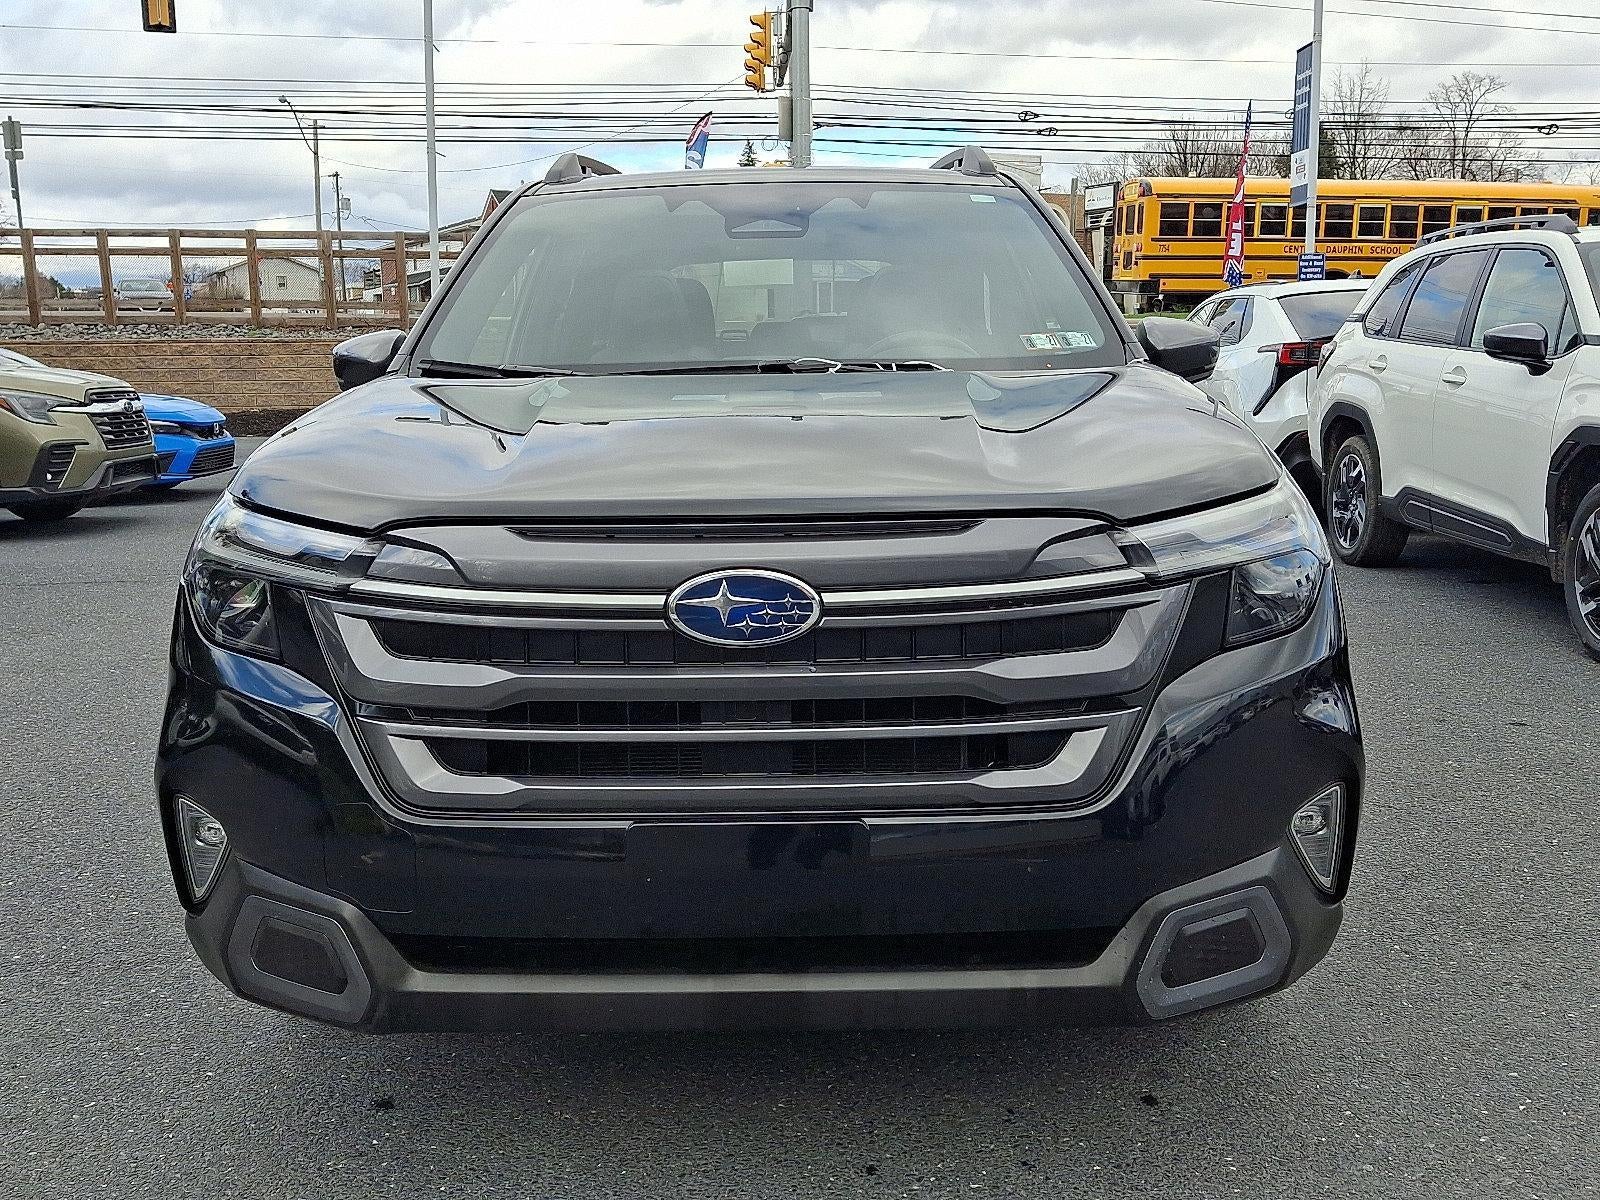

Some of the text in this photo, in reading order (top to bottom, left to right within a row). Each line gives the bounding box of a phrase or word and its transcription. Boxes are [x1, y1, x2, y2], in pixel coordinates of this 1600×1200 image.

[1158, 244, 1170, 253] 7754
[1283, 245, 1319, 254] CENTL
[1326, 245, 1364, 254] DAUPHIN
[1370, 245, 1403, 254] SCHOOL
[1046, 334, 1058, 346] 27
[1081, 333, 1093, 345] 27
